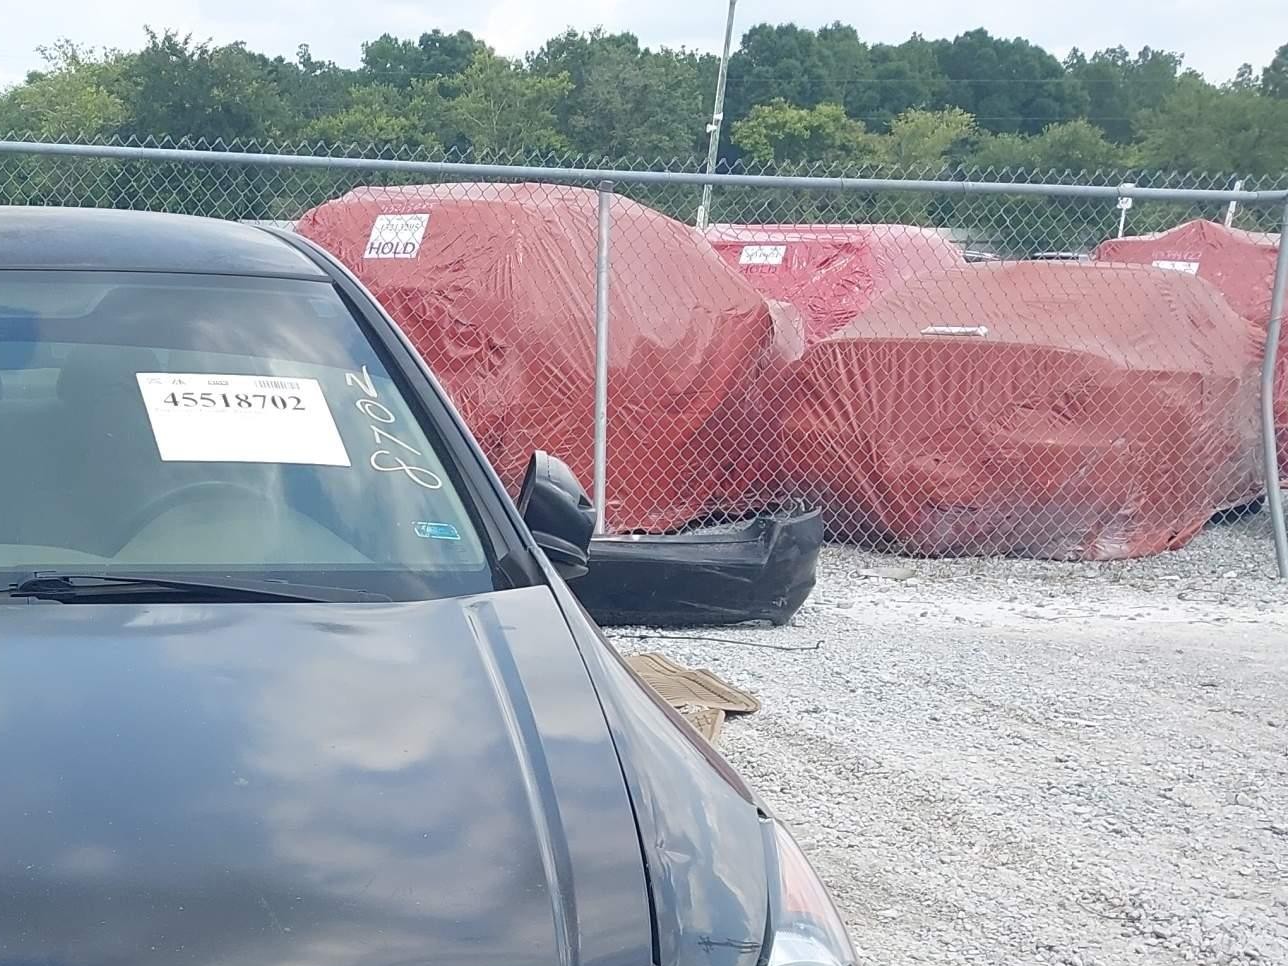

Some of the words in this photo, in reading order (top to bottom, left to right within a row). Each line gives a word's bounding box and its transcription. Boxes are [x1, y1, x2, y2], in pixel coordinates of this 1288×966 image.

[368, 241, 416, 255] HOLD
[163, 391, 306, 411] 45518702
[344, 365, 443, 490] 8702
